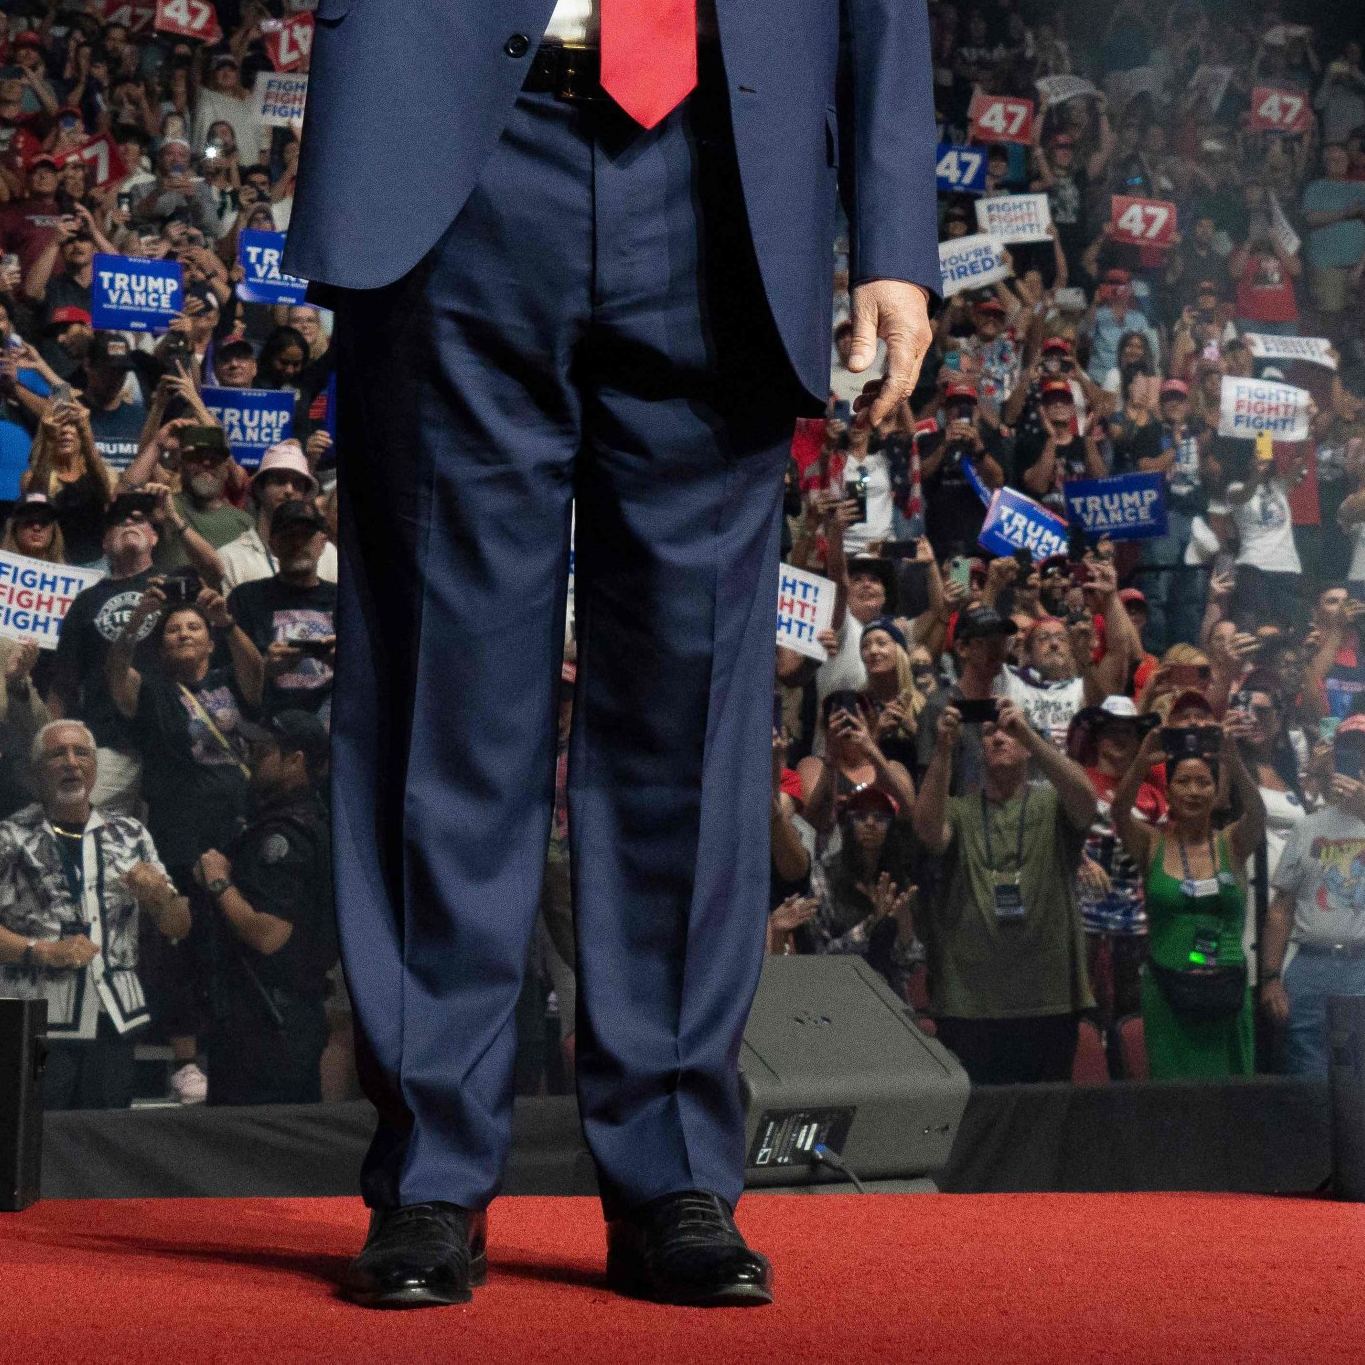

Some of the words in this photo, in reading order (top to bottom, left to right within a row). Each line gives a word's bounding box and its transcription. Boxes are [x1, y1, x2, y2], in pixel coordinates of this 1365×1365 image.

[267, 79, 306, 93] FIGH
[265, 92, 305, 105] FIGH
[1258, 92, 1304, 124] 47
[262, 105, 302, 118] FIGH
[978, 103, 1028, 135] 47
[936, 150, 983, 185] 47
[1118, 203, 1169, 240] 47
[99, 271, 179, 294] TRUMP
[107, 290, 172, 309] VANCE
[207, 406, 290, 428] TRUMP
[1234, 415, 1296, 432] FIGHT!
[94, 442, 139, 455] RUM
[1070, 489, 1159, 515] TRUMP
[1083, 506, 1152, 527] VANCE
